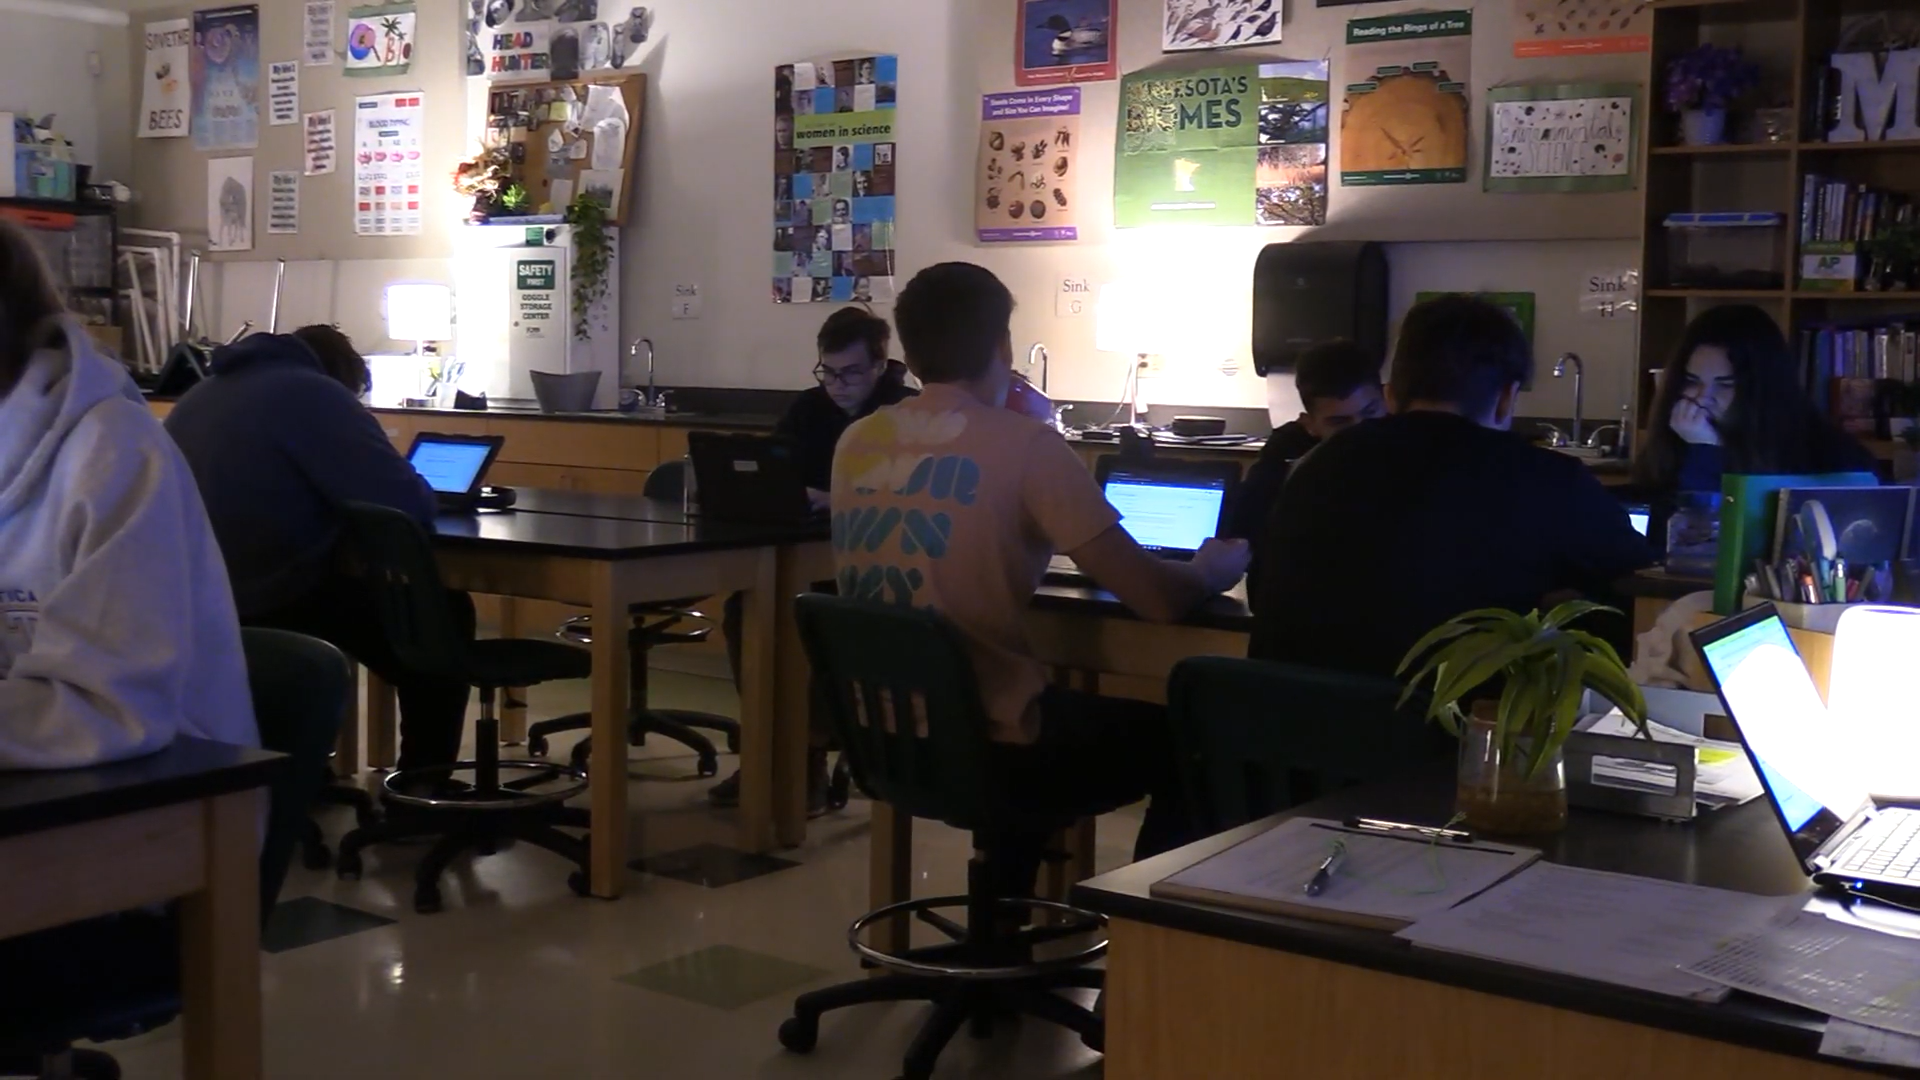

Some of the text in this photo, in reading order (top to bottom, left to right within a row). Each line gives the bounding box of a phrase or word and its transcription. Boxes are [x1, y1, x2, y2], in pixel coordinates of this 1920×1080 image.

[1353, 27, 1386, 37] Reading
[1388, 25, 1402, 34] the
[1404, 23, 1428, 33] Rings
[1429, 21, 1439, 31] of
[1446, 20, 1465, 29] Tree
[492, 31, 534, 50] HEAD
[491, 53, 551, 72] HUNTER
[1174, 76, 1248, 97] SOTA'S
[1034, 95, 1052, 104] Every
[1053, 94, 1073, 103] Shape
[1828, 49, 1920, 142] M
[1017, 106, 1028, 114] You
[1029, 105, 1041, 113] Can
[1179, 98, 1242, 130] MES
[148, 109, 183, 131] BEES
[796, 124, 891, 139] women in science
[519, 264, 553, 276] SAFETY
[1062, 278, 1090, 293] Sink
[1588, 275, 1627, 293] Sink
[522, 293, 550, 301] GOGGLE
[520, 302, 553, 311] STORAGE
[683, 303, 689, 315] F
[1070, 299, 1082, 314] G
[522, 312, 551, 320] CENTER
